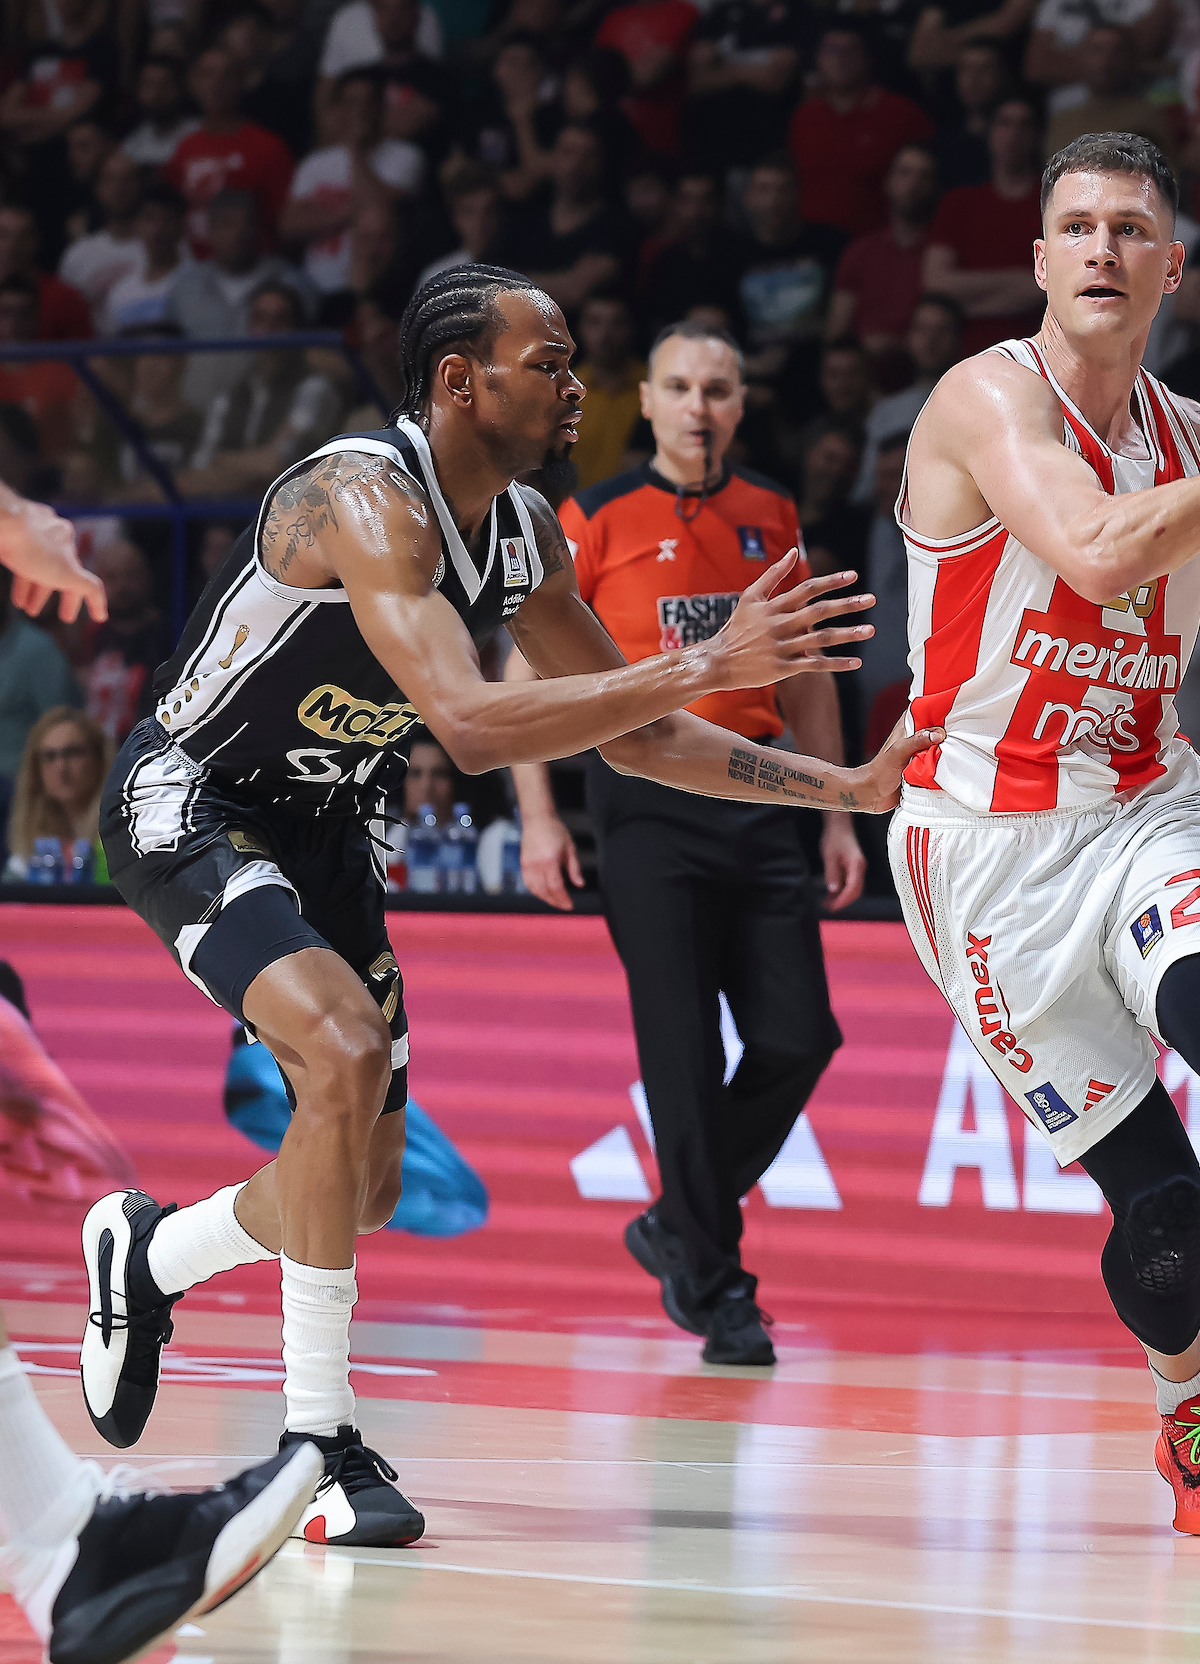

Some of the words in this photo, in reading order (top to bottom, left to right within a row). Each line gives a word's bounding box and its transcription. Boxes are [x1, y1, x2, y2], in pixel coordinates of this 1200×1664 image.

[662, 594, 741, 625] FASHI
[303, 690, 420, 740] MOZZ
[728, 767, 754, 786] NEVER
[729, 756, 756, 776] NEVER
[965, 931, 1033, 1074] carnex
